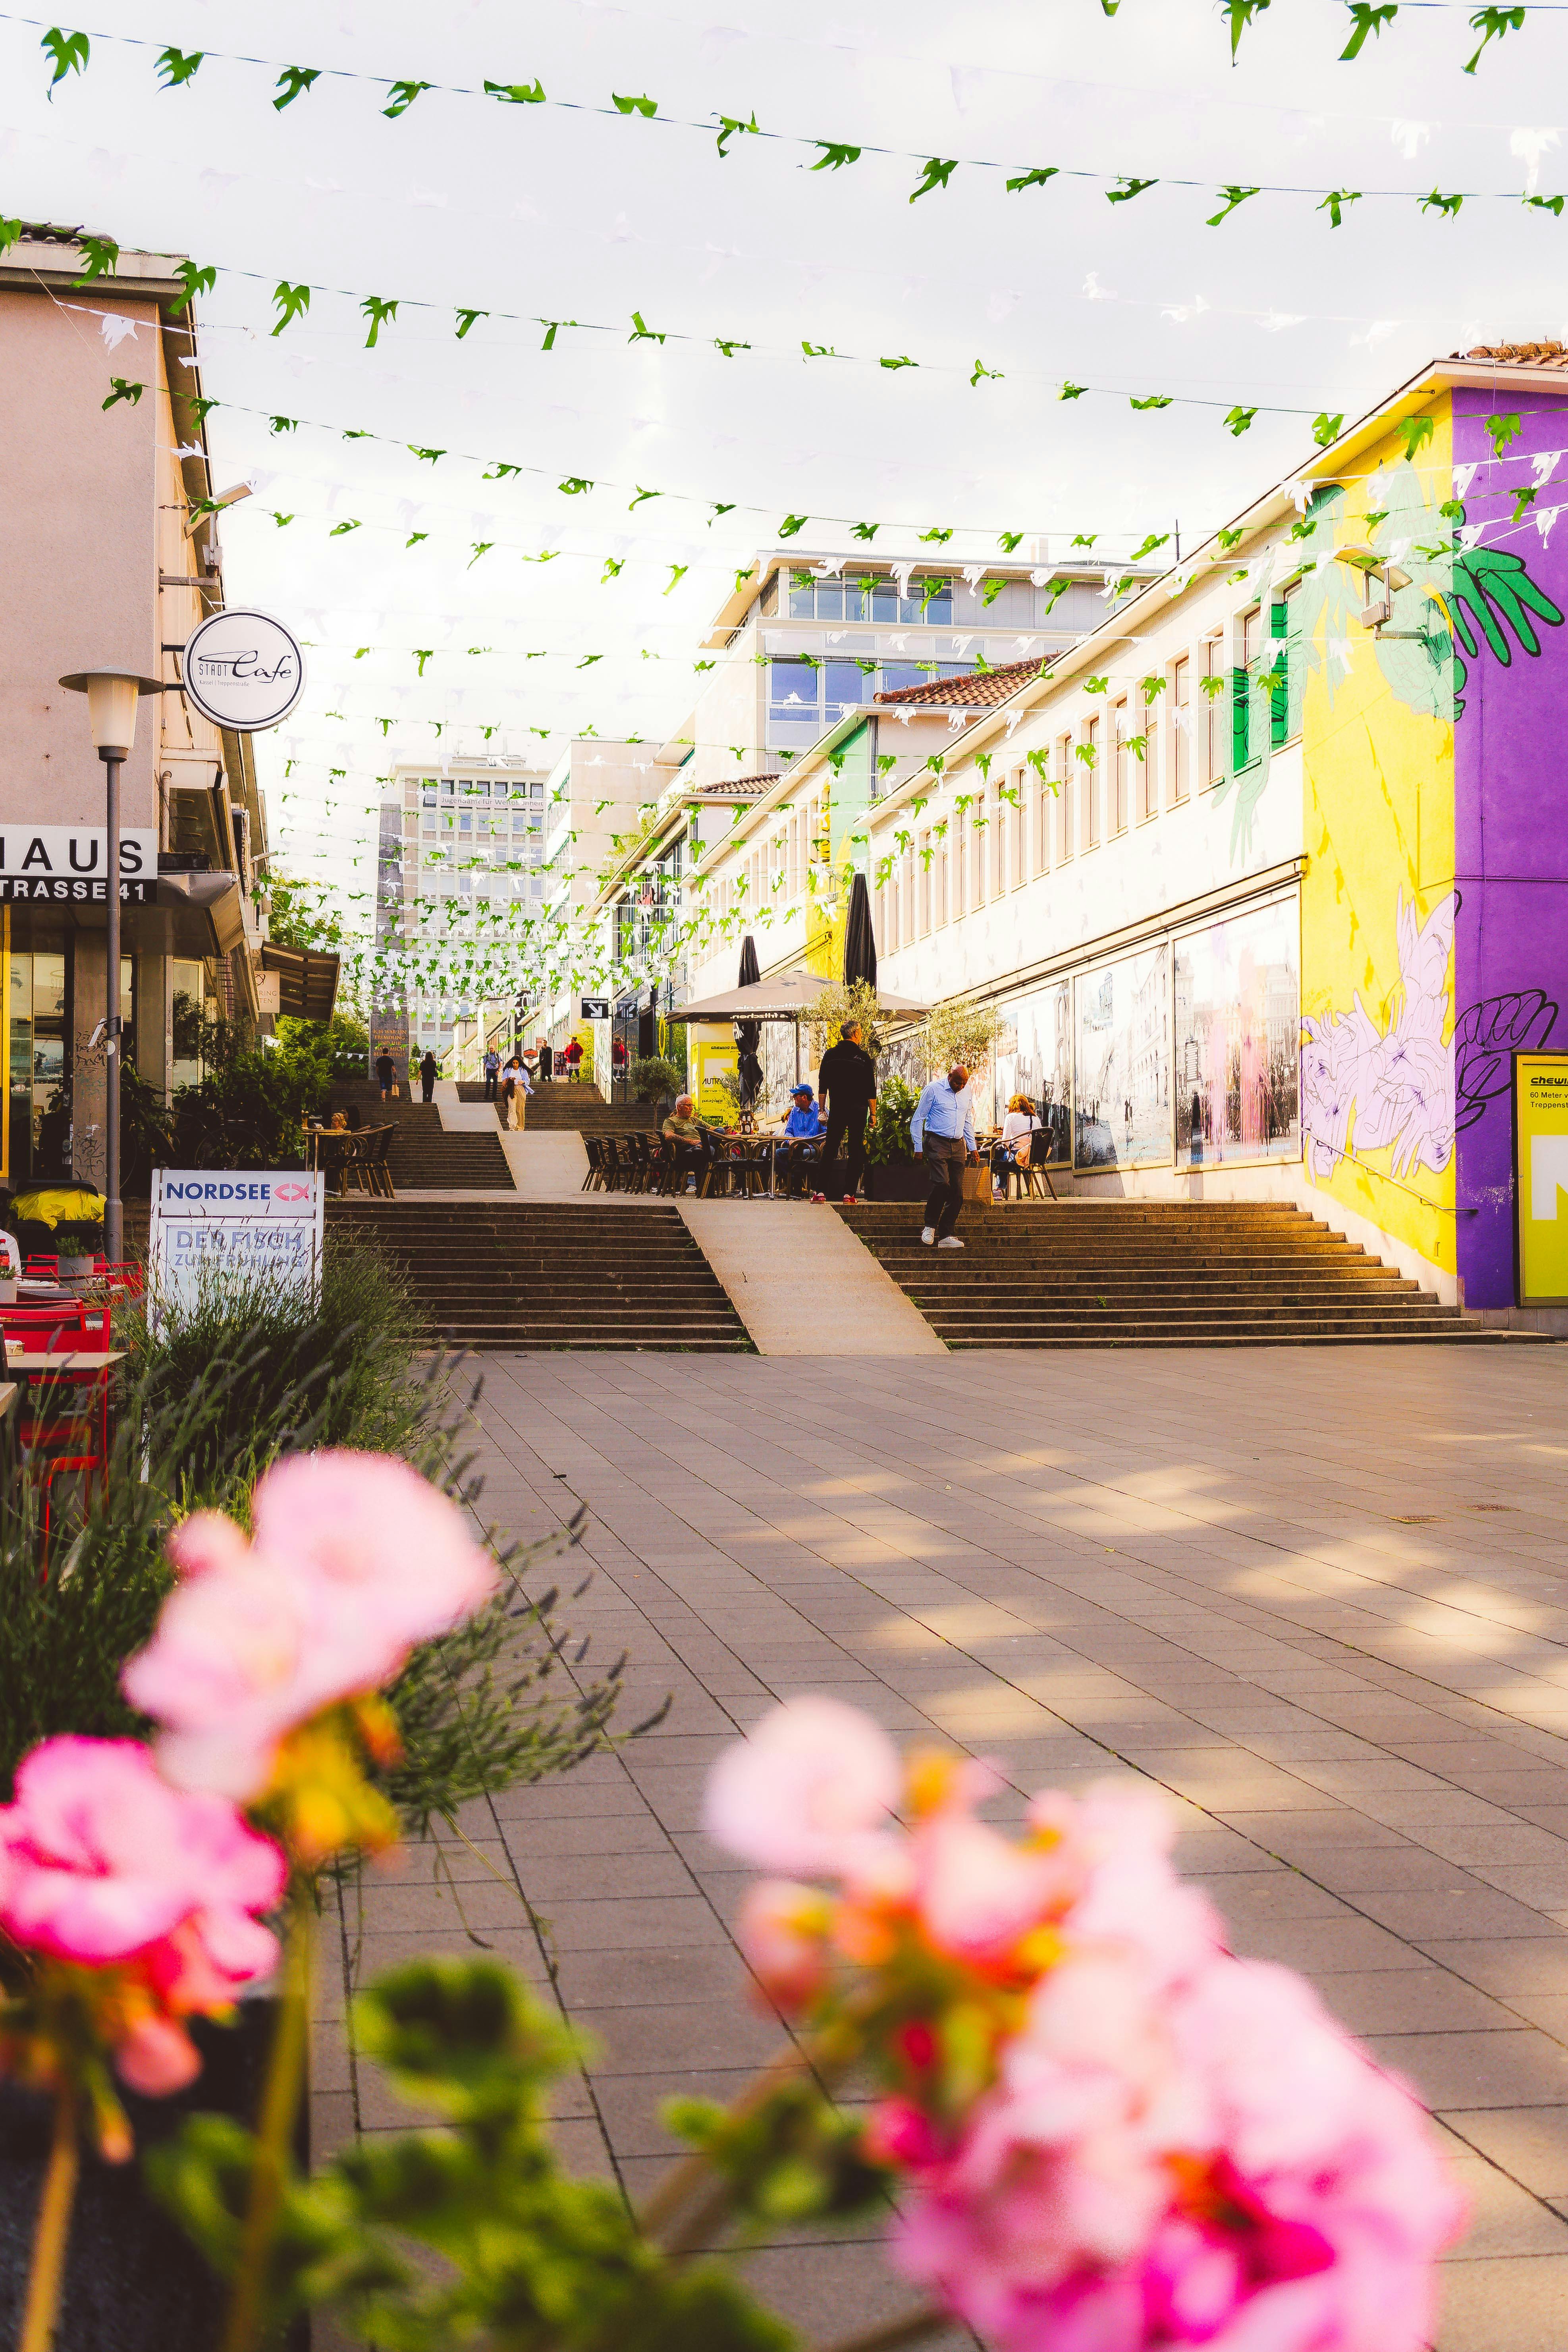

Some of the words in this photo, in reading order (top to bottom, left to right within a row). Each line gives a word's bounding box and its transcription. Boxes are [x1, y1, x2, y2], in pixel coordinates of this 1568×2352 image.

[199, 664, 228, 676] STADT
[119, 883, 144, 900] 41
[1530, 1076, 1568, 1086] chewi
[166, 1182, 270, 1200] NORDSEE
[177, 1231, 223, 1248] DER
[232, 1232, 302, 1249] FISCH
